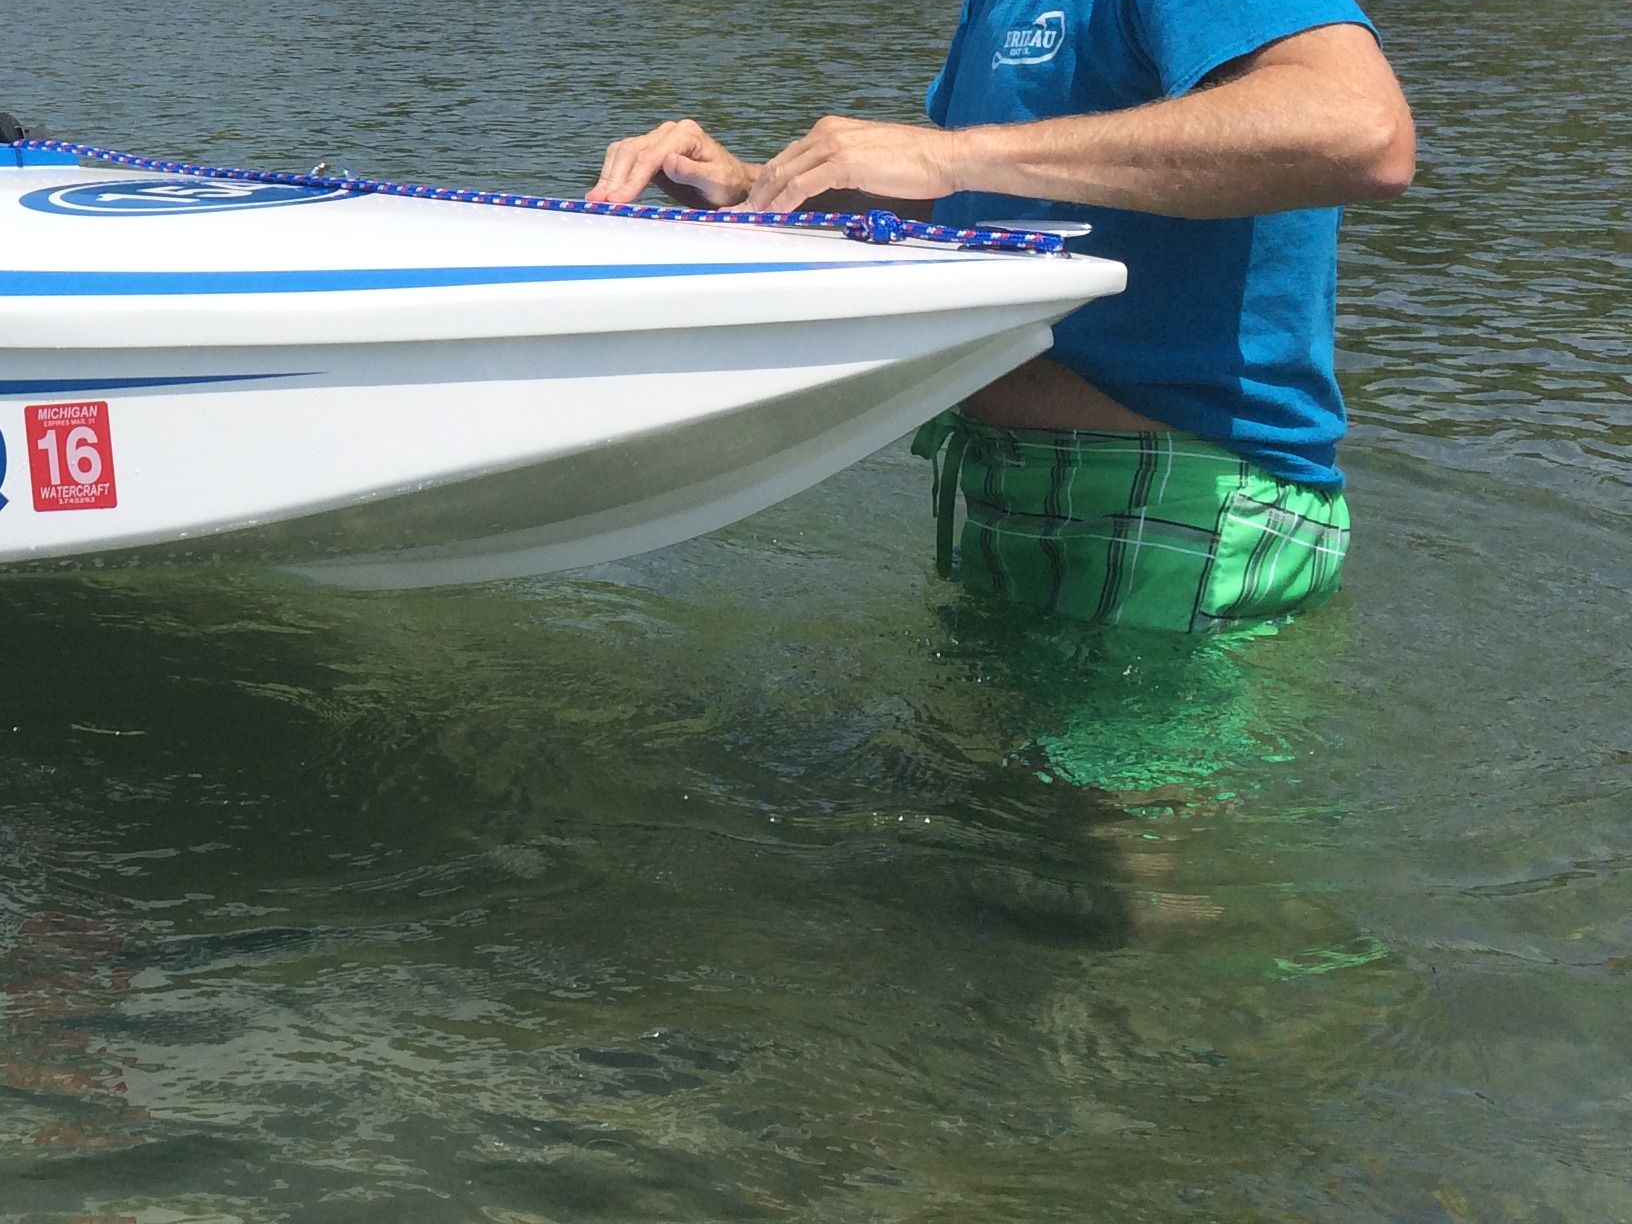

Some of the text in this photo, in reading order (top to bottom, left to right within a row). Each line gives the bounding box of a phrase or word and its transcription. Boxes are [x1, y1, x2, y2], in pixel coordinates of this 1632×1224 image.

[38, 405, 98, 420] MICHIGAN
[37, 426, 102, 484] 16
[40, 483, 109, 498] WATERCRAFT
